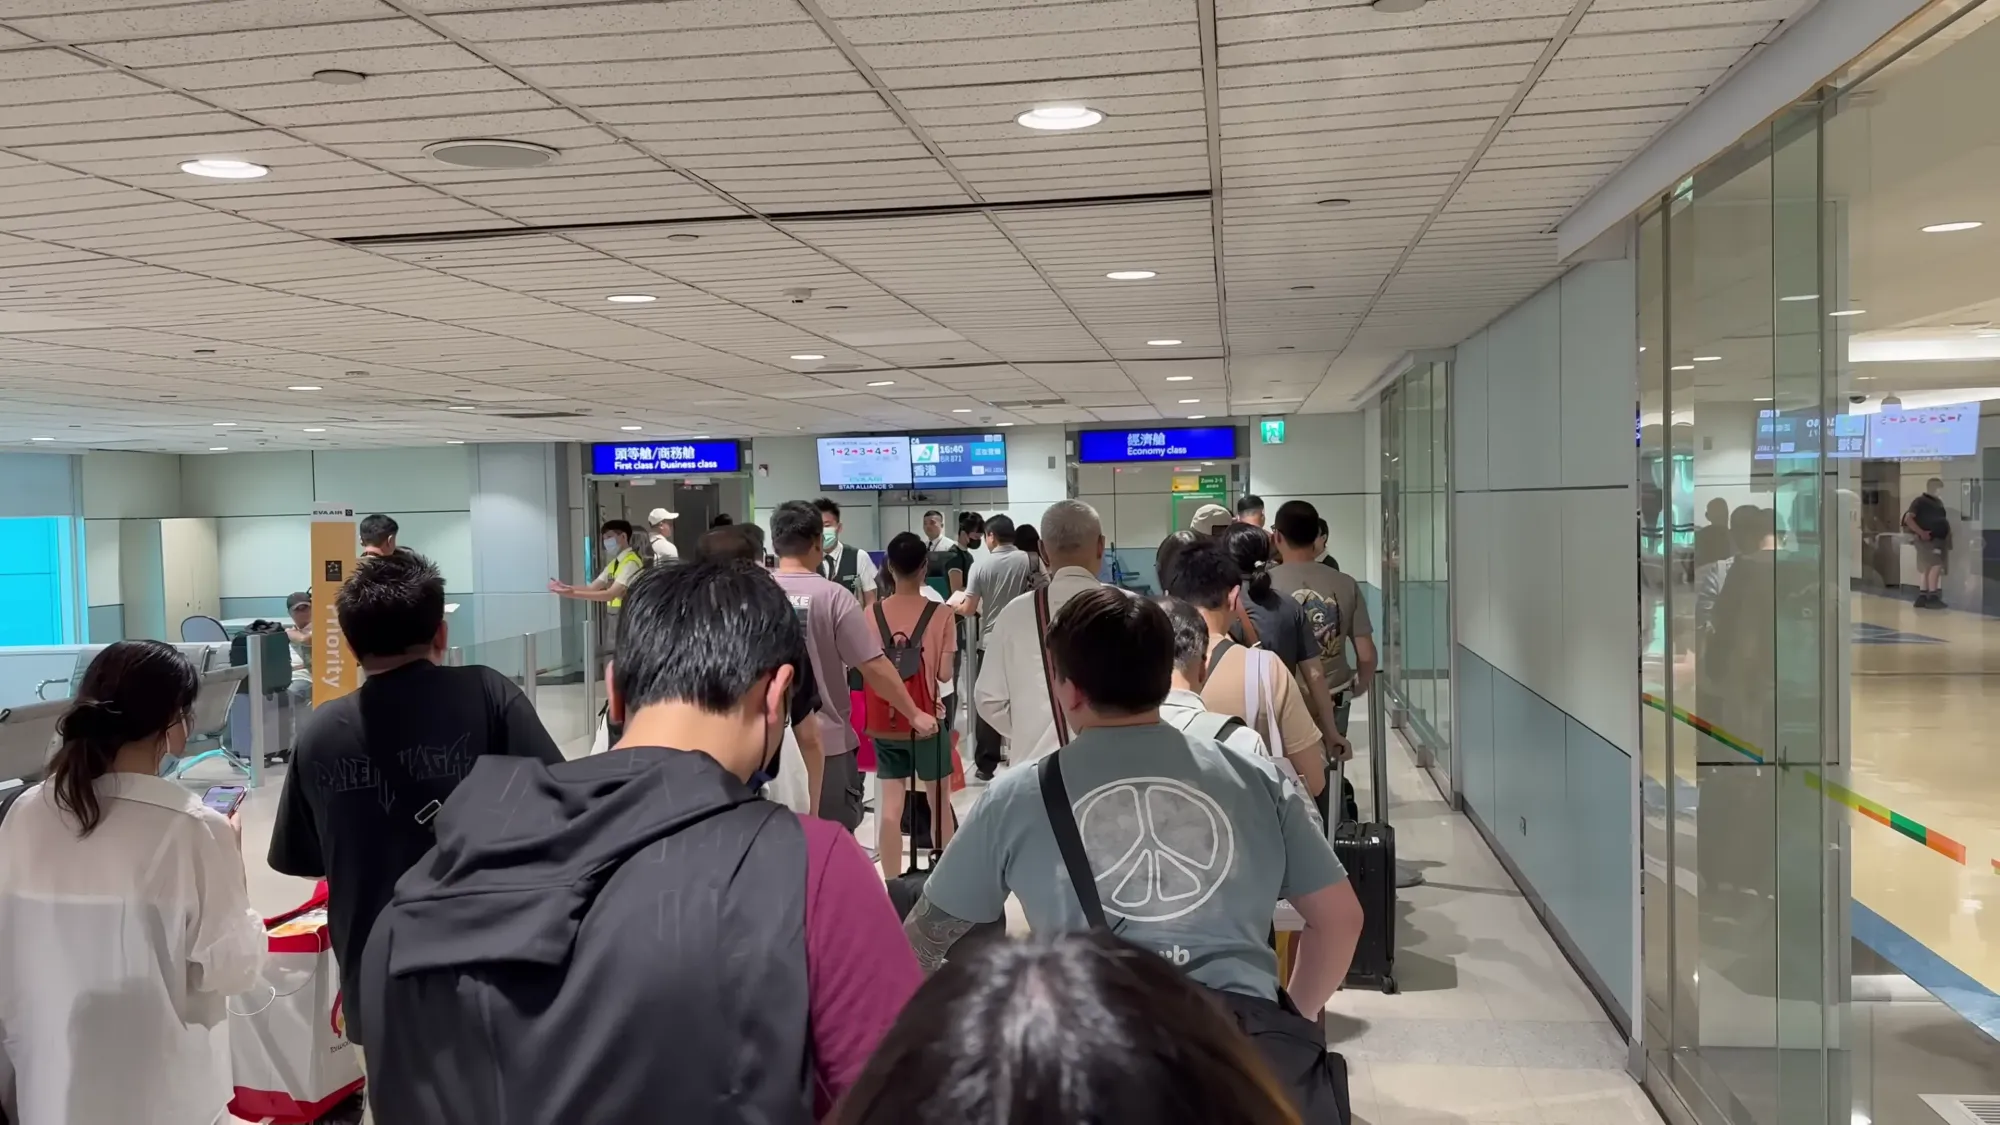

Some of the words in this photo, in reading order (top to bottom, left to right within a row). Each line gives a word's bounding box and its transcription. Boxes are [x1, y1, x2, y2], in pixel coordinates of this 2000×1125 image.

[1127, 432, 1166, 447] 經濟艙
[844, 447, 850, 456] 2
[859, 447, 866, 455] 3
[875, 447, 881, 455] 4
[891, 446, 898, 455] 5
[940, 445, 964, 454] 16:40
[1127, 447, 1165, 457] Economy
[1167, 446, 1187, 454] class
[614, 461, 632, 470] First
[633, 461, 653, 470] class
[660, 460, 696, 470] Business
[697, 460, 718, 468] class
[914, 464, 937, 476] 香港
